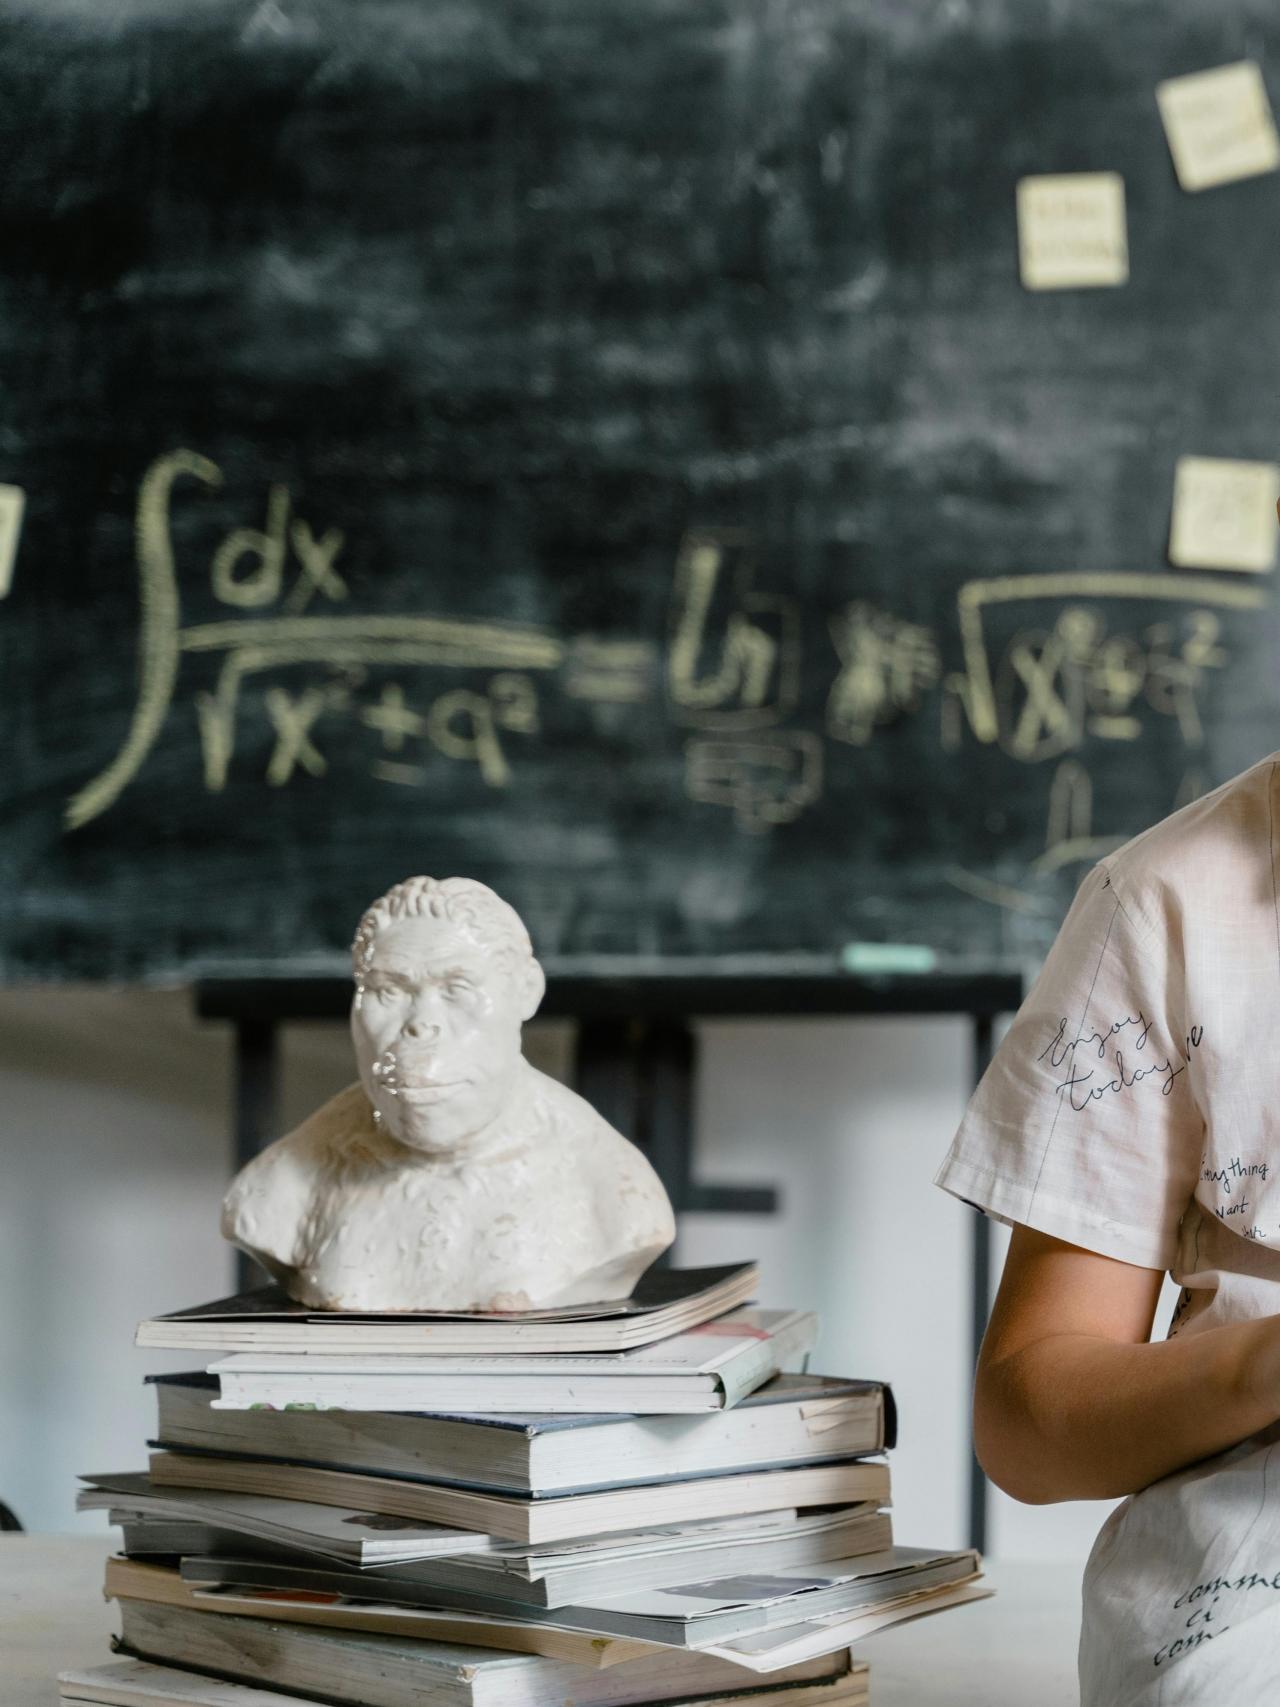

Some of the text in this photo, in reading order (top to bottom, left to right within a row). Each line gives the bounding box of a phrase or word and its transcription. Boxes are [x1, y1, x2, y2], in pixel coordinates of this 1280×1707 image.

[1038, 1011, 1153, 1067] Enjoy
[1056, 1051, 1185, 1111] today
[1186, 1596, 1220, 1628] ci
